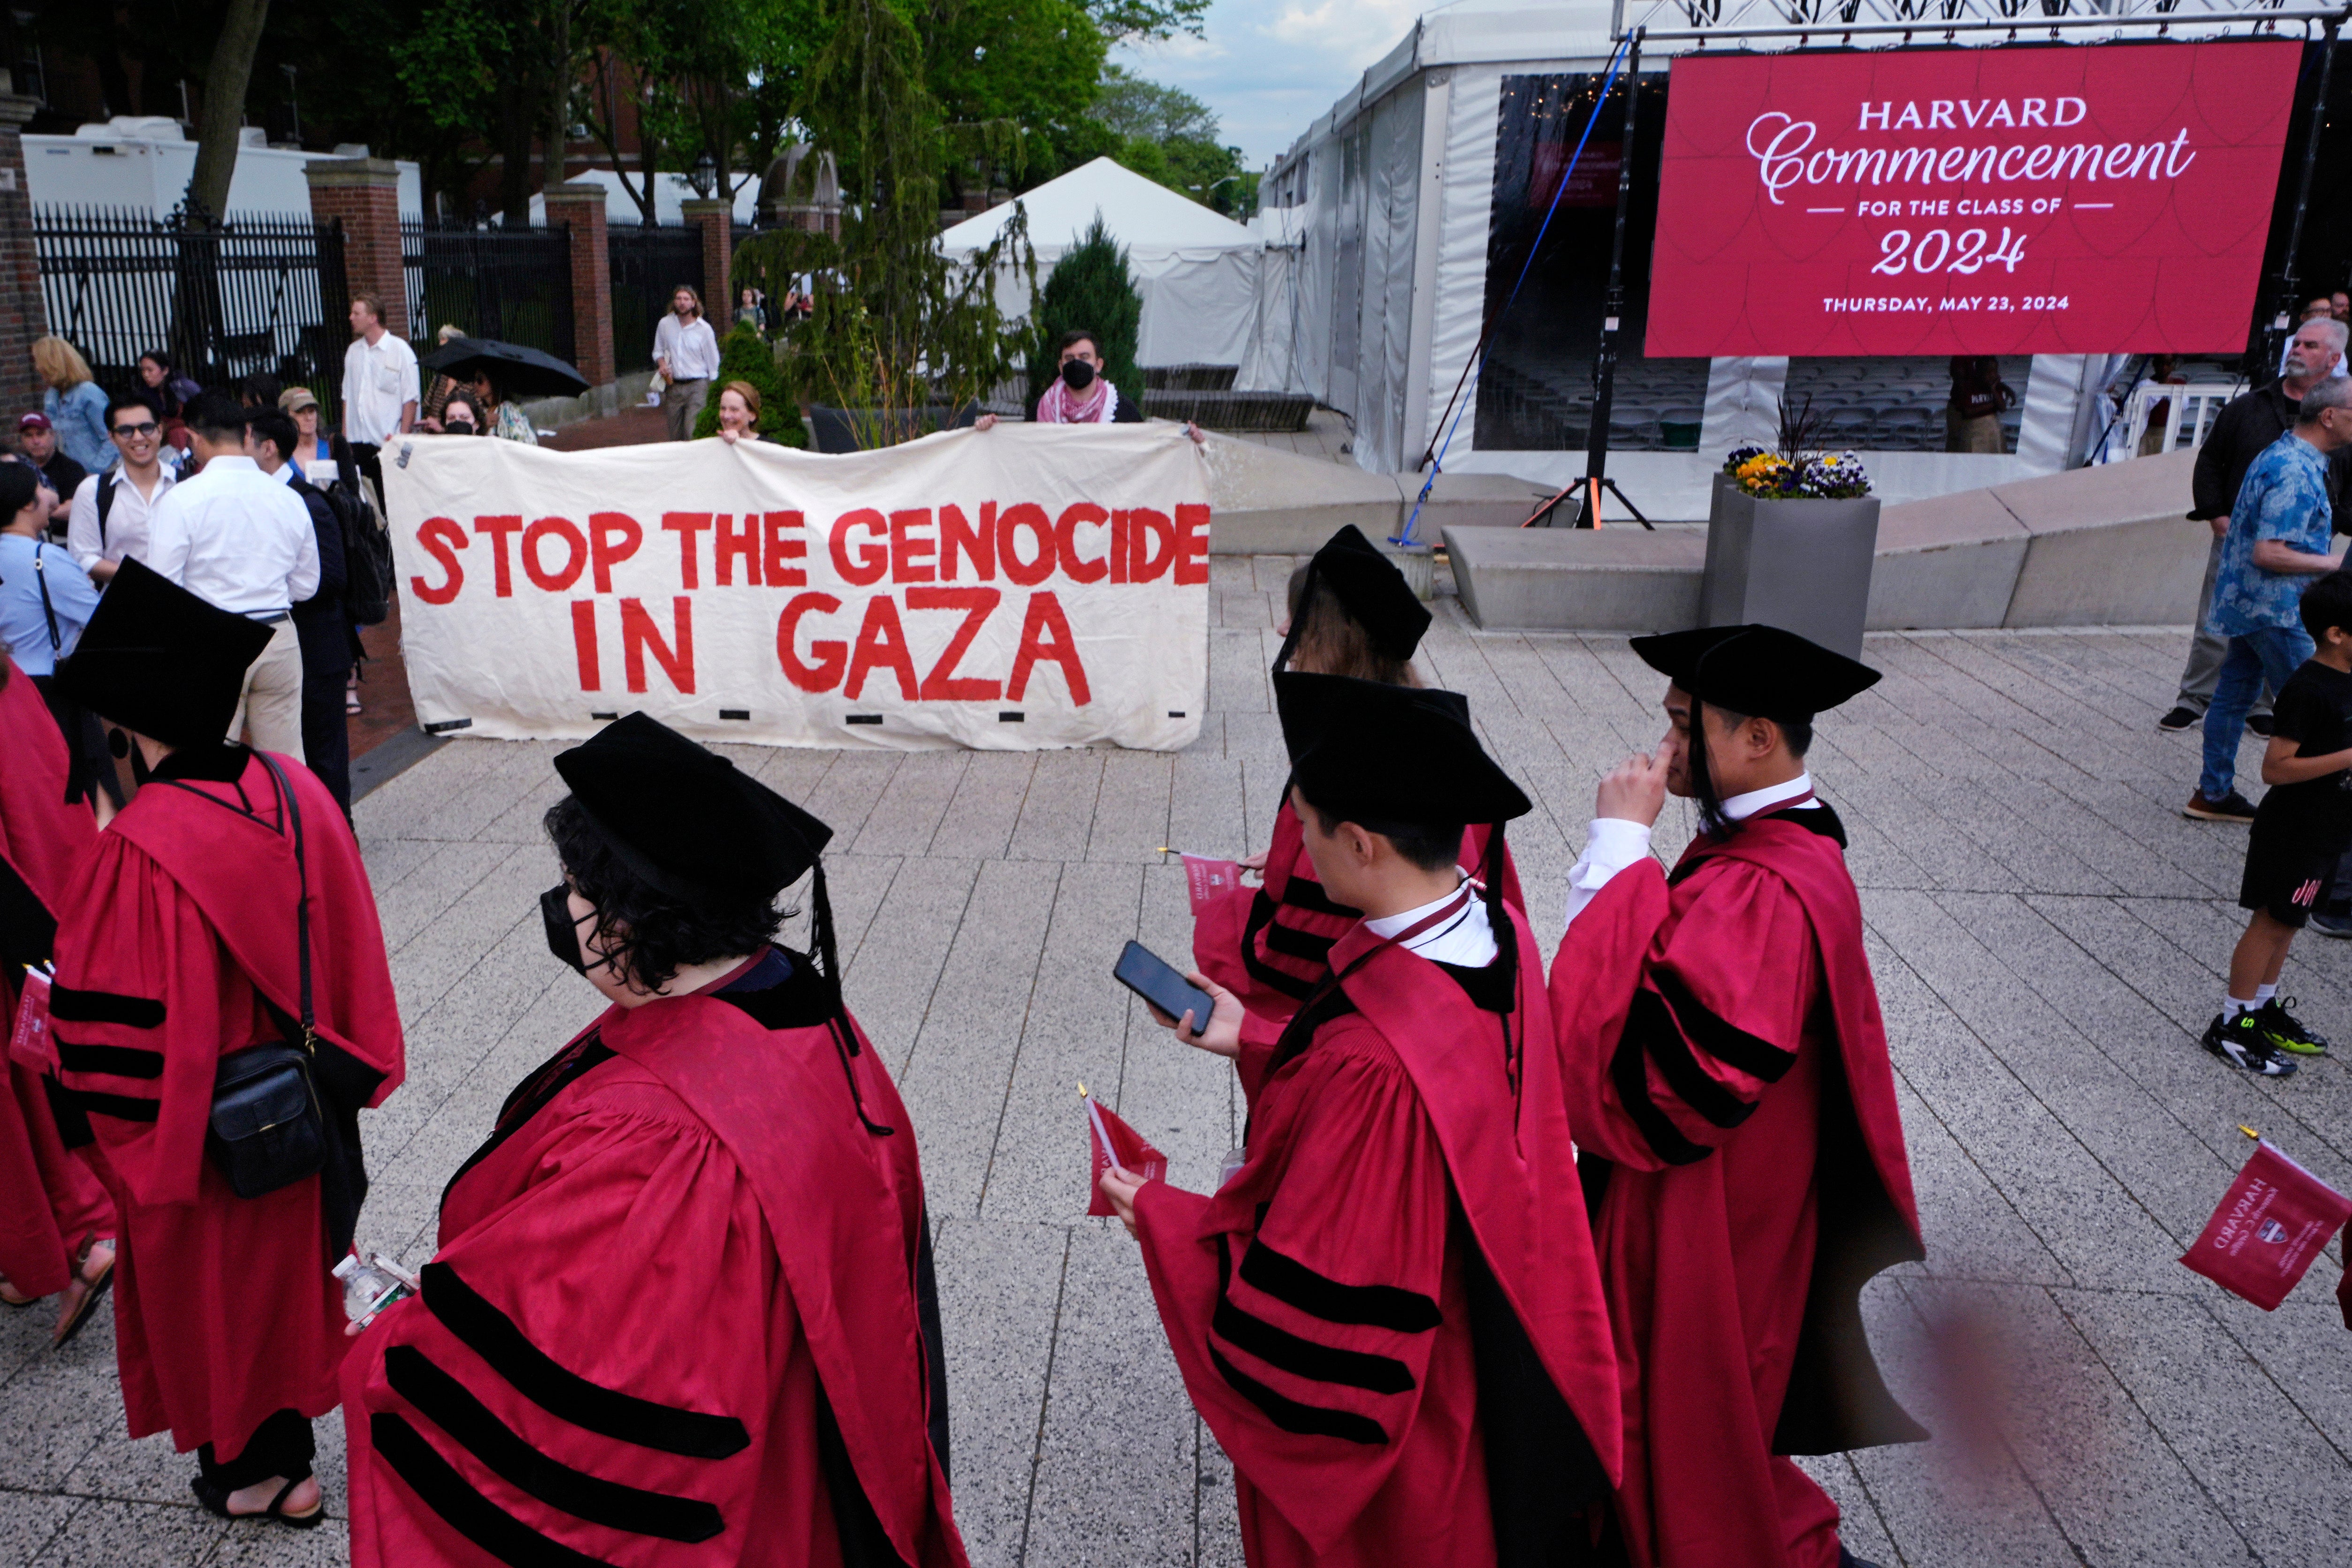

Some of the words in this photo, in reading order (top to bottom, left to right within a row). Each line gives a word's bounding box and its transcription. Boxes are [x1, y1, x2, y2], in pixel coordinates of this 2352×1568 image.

[1857, 96, 2087, 130] HARVARD
[1746, 111, 2197, 205] Commencement
[1857, 201, 1902, 217] FOR
[1909, 200, 1950, 216] THE
[1957, 198, 2030, 215] CLASS
[2031, 197, 2062, 214] OF
[1871, 226, 2027, 275] 2024
[1823, 297, 1933, 314] THURSDAY,
[1939, 296, 1982, 311] MAY
[1987, 296, 2015, 313] 23,
[2021, 295, 2070, 311] 2024
[411, 512, 643, 605] STOP
[662, 511, 807, 590] THE
[829, 501, 1210, 586] GENOCIDE
[572, 597, 695, 694] IN
[777, 587, 1091, 706] GAZA
